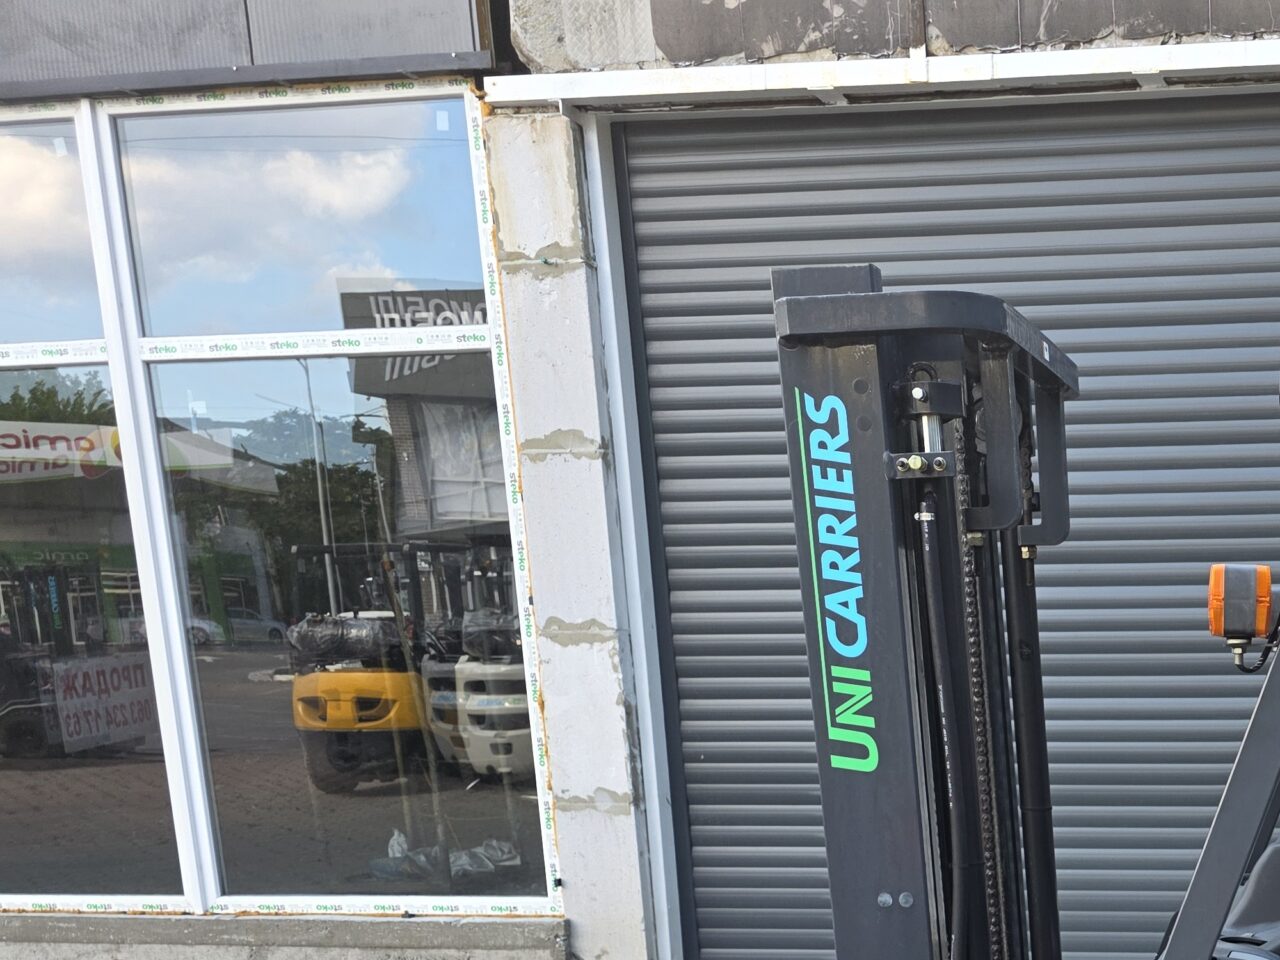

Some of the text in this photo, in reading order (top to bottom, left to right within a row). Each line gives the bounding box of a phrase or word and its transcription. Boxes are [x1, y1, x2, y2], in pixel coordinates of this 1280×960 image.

[258, 88, 288, 98] steko
[321, 85, 351, 95] steko
[384, 81, 415, 91] steko
[471, 116, 481, 151] steko
[479, 190, 489, 224] steko
[486, 262, 496, 296] steko
[149, 345, 177, 354] steko
[209, 343, 238, 352] steko
[270, 340, 299, 349] steko
[331, 337, 361, 347] steko
[456, 333, 486, 343] steko
[494, 334, 504, 367] steko
[502, 403, 511, 436] steko
[509, 472, 518, 504] steko
[516, 540, 526, 572] steko
[523, 607, 532, 638] steko
[530, 672, 539, 703] steko
[537, 737, 546, 768] steko
[543, 801, 552, 830] steko
